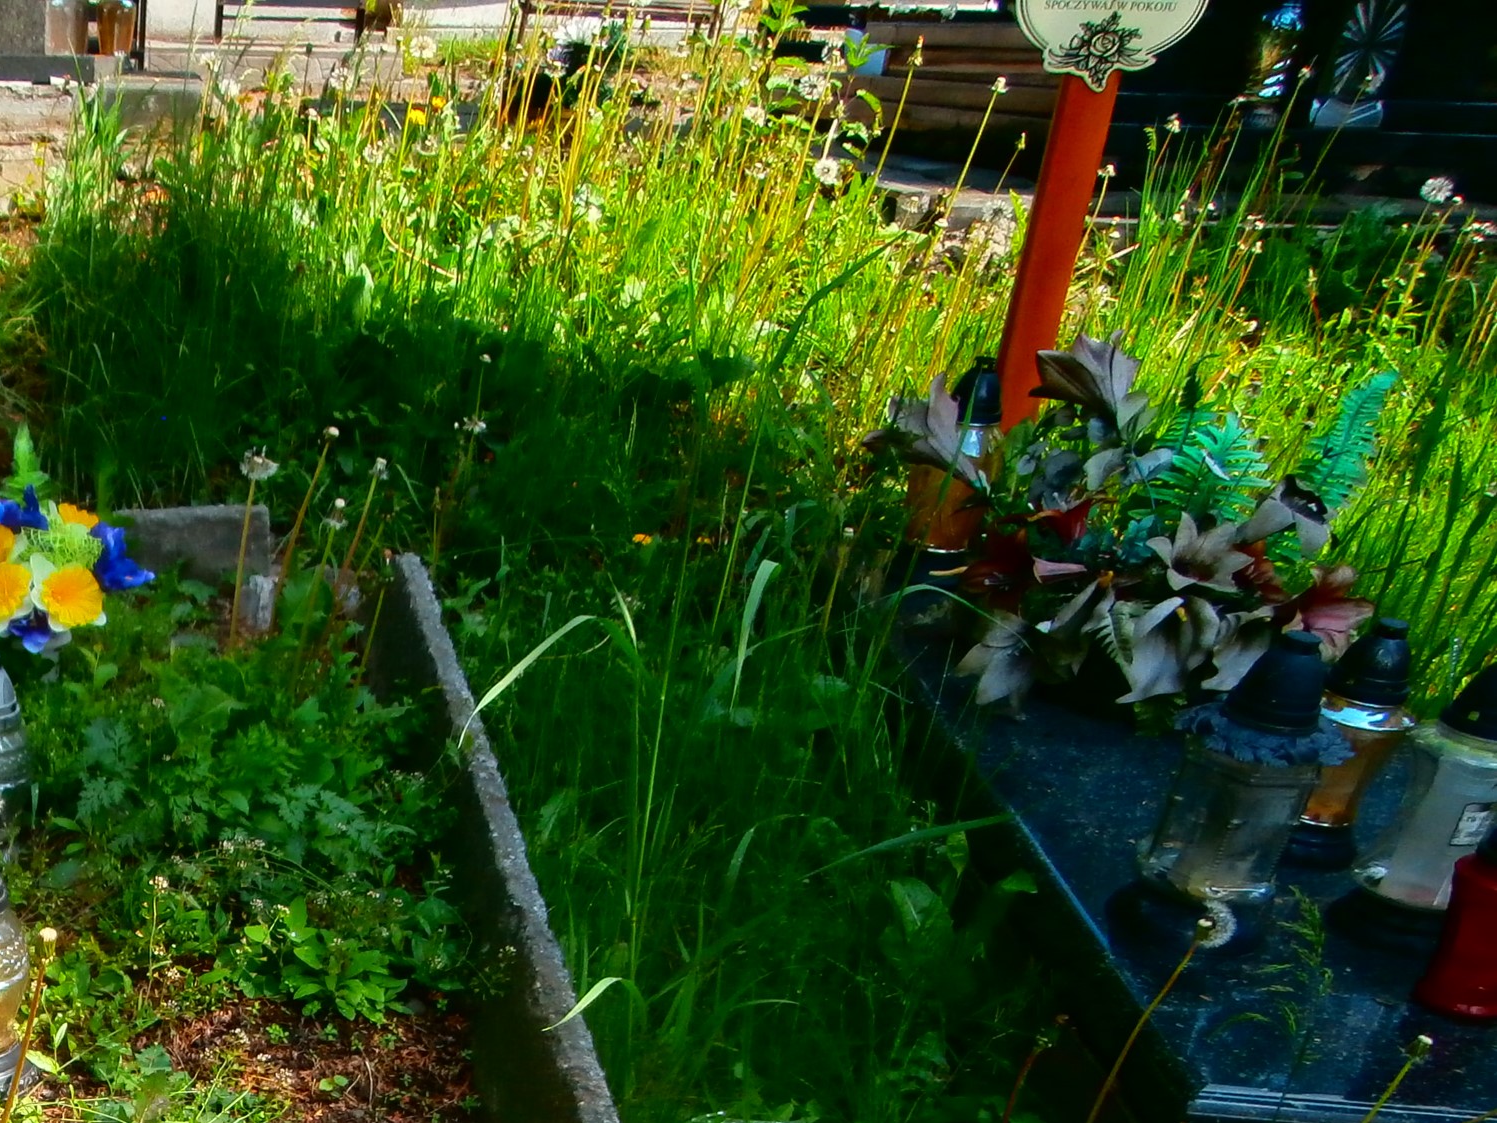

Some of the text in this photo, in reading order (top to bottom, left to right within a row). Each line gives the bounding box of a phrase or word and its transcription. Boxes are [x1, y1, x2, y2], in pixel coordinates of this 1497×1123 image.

[1043, 0, 1178, 12] SPOCZYWAJ W POKOJU
